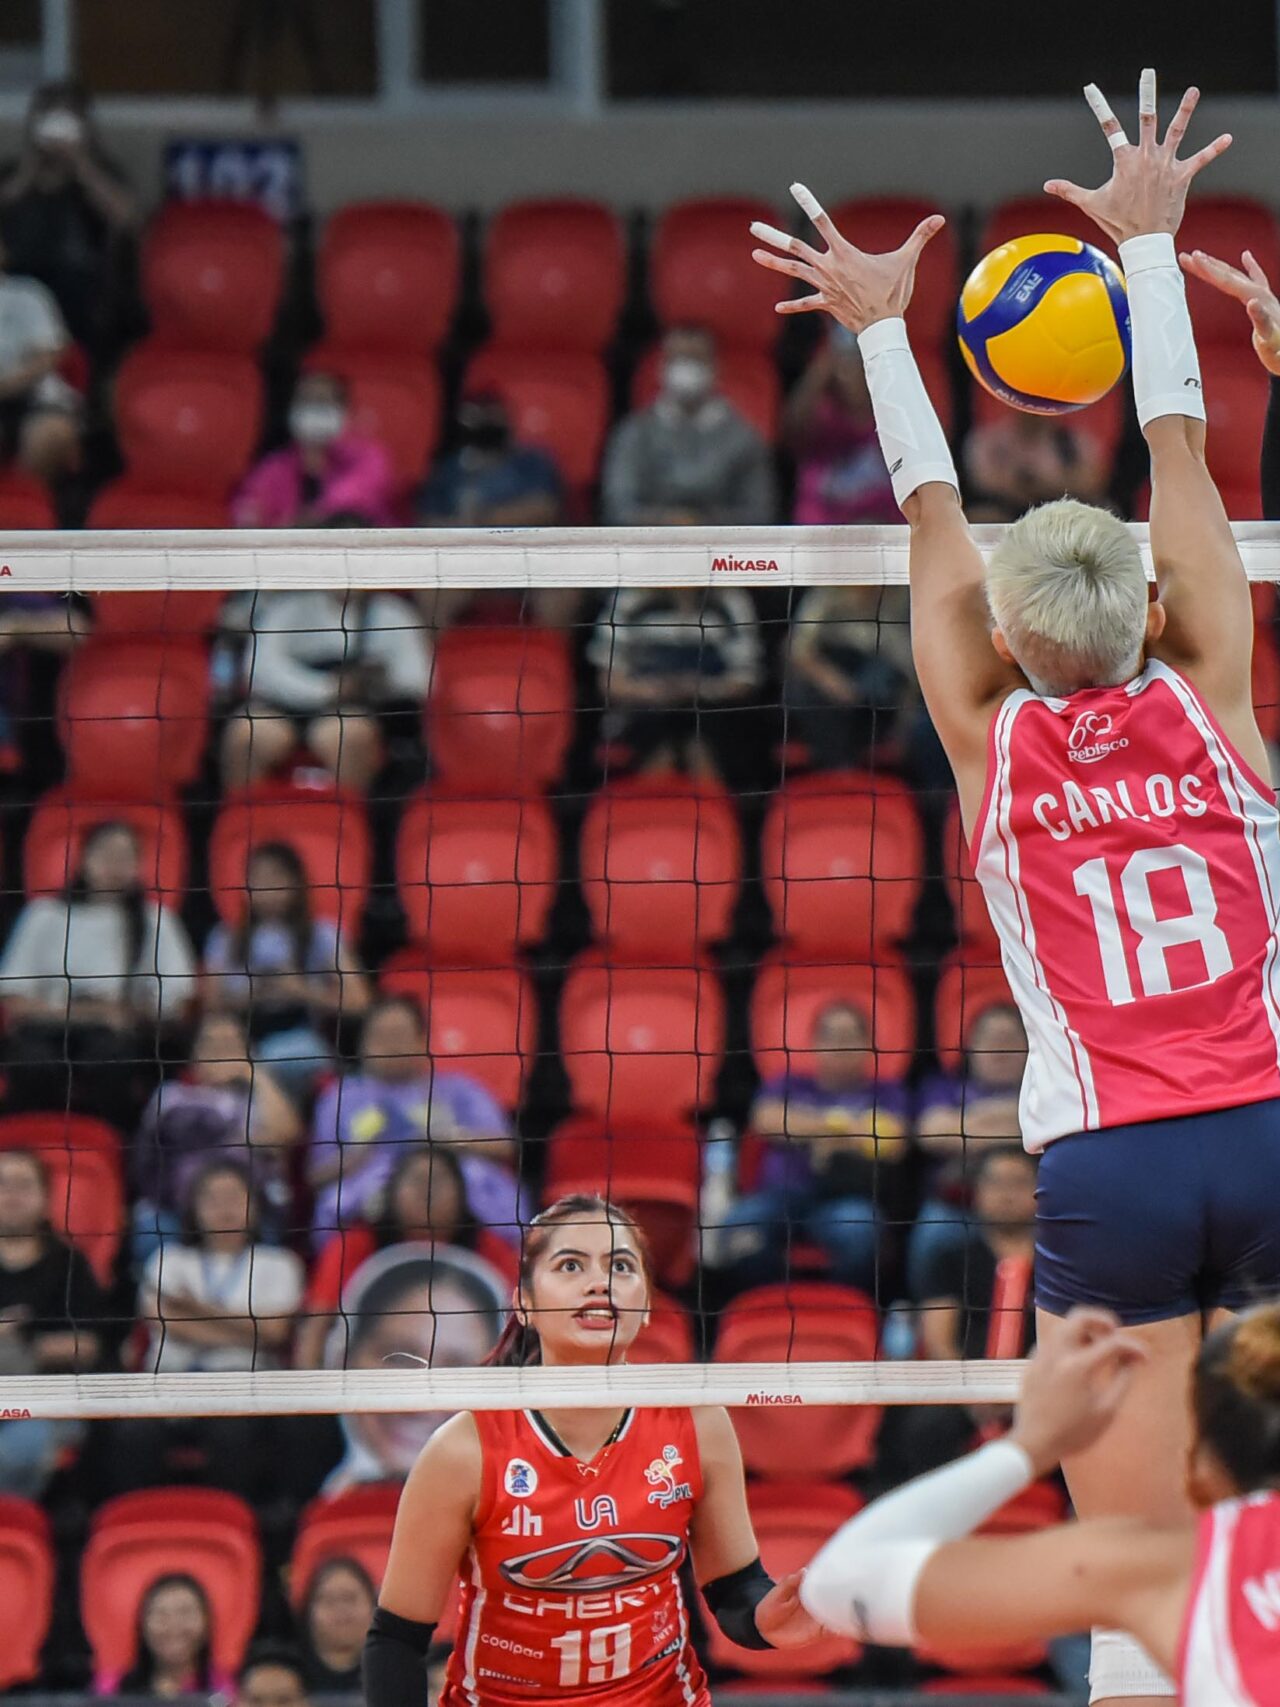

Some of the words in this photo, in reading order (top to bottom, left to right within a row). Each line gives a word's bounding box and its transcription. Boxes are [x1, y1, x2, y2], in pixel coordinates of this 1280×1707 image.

[1015, 272, 1044, 303] FIVB
[1067, 738, 1129, 763] Rebisco
[1032, 773, 1208, 841] CARLOS
[1072, 843, 1234, 1007] 18
[0, 1408, 31, 1418] ASA
[674, 1485, 691, 1500] PVL
[480, 1633, 545, 1660] coolpad
[550, 1622, 631, 1687] 19
